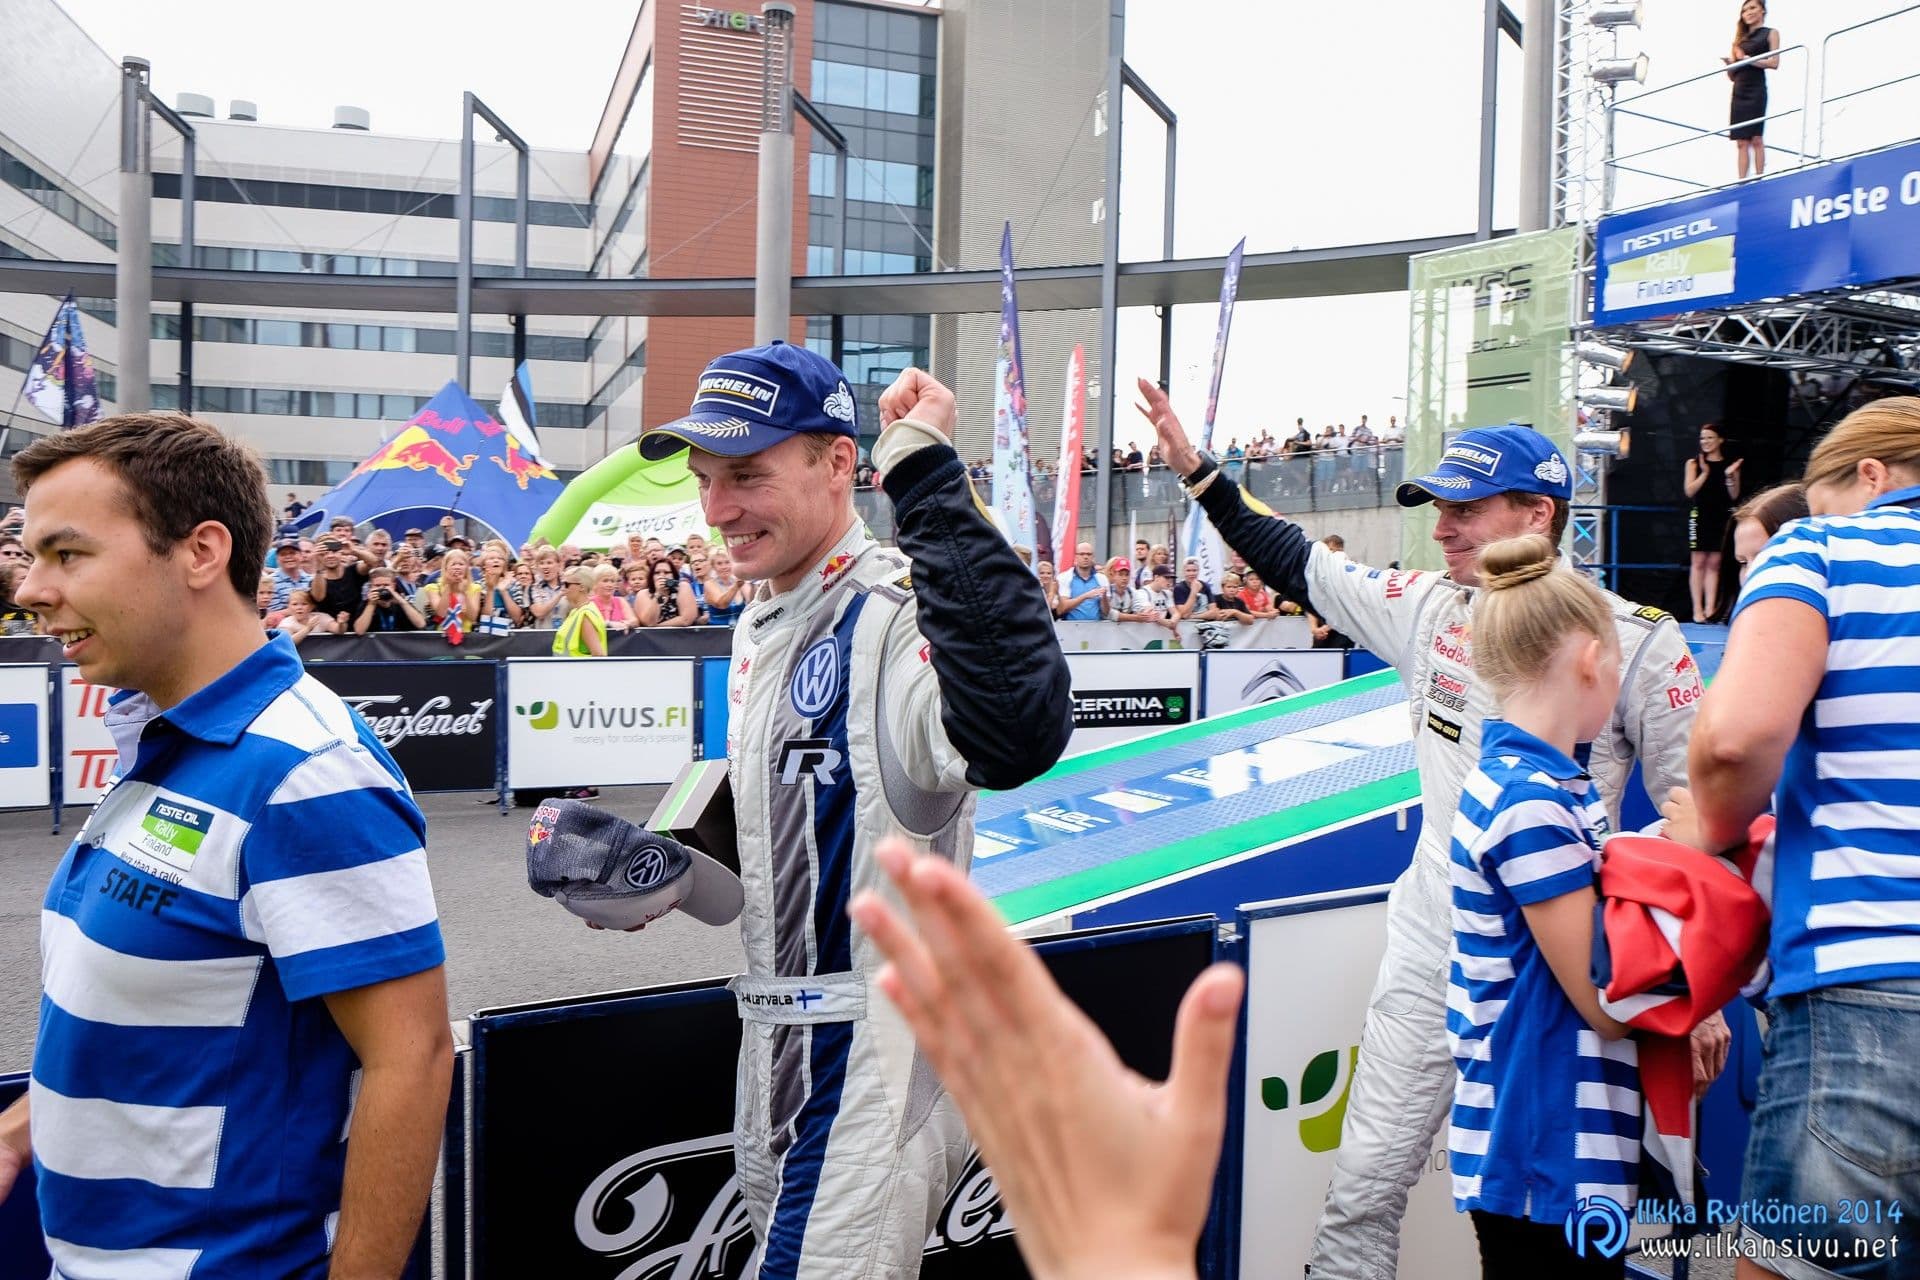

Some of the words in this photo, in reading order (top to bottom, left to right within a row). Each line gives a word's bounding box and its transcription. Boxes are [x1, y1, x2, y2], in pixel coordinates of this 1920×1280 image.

[1790, 186, 1890, 229] Neste
[1646, 250, 1691, 274] Rally
[1637, 276, 1694, 299] Finland
[700, 378, 773, 402] MICHELIN
[1108, 711, 1162, 719] WATCHES
[153, 819, 179, 842] Rally
[142, 833, 173, 857] Finland
[132, 859, 150, 874] than
[99, 867, 178, 917] STAFF
